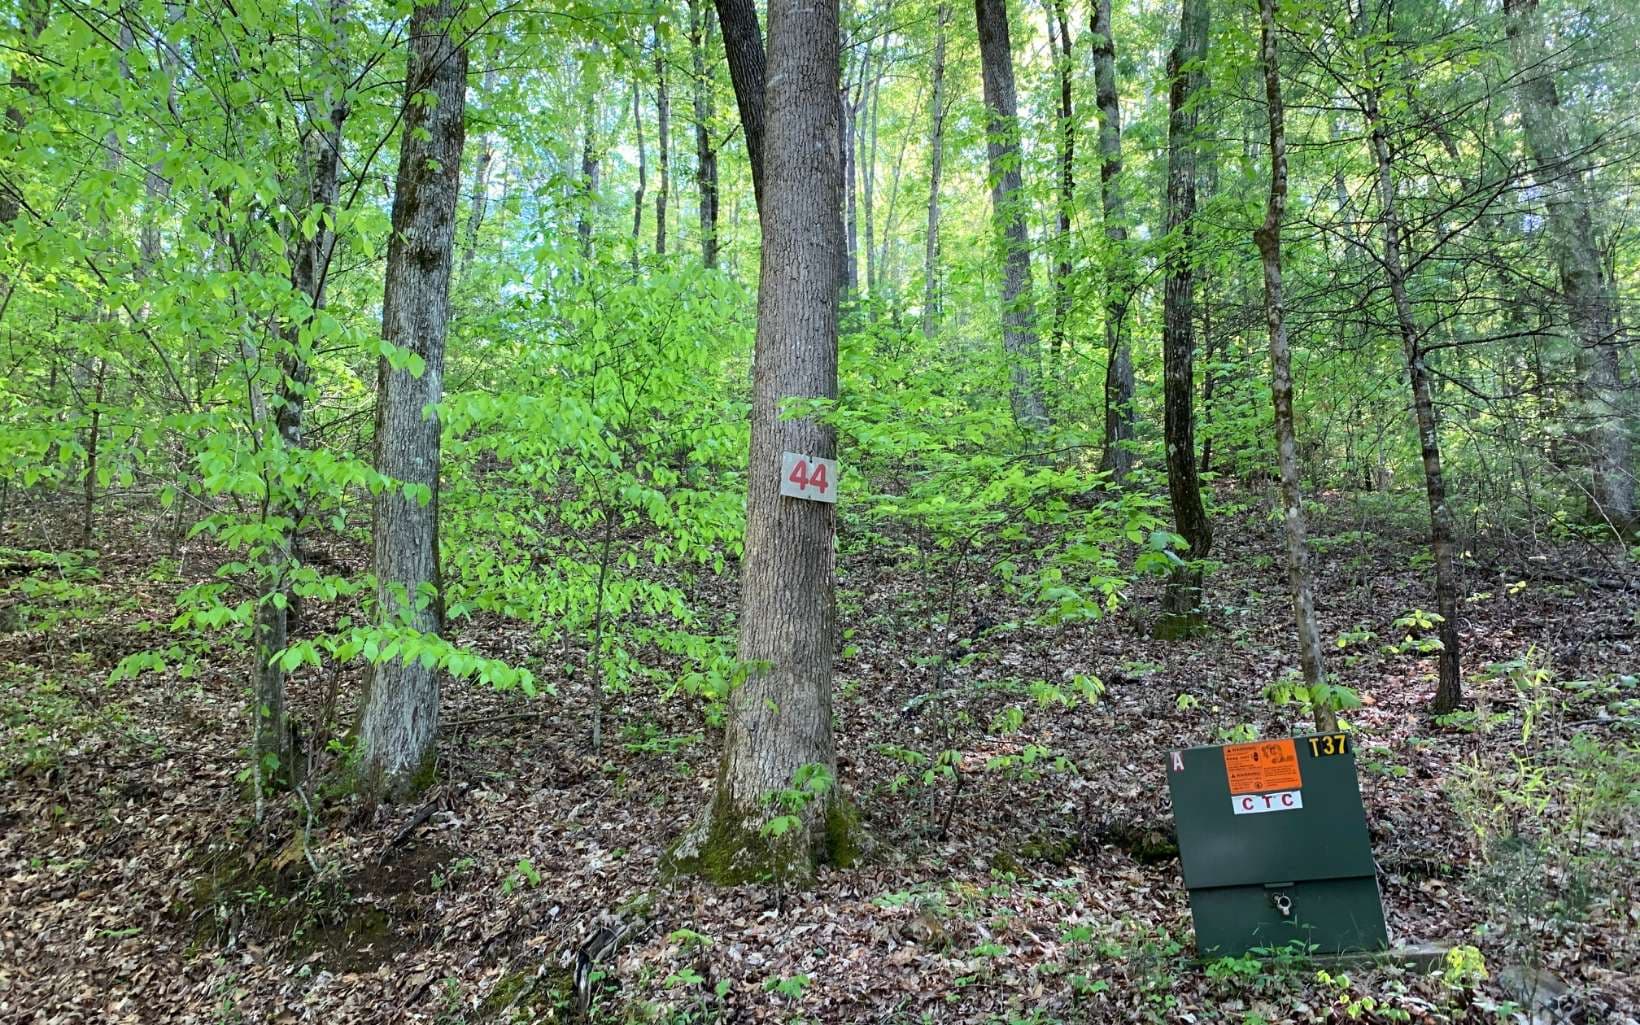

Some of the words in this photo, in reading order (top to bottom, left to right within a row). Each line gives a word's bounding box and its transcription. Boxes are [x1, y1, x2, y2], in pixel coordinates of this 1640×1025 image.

[789, 460, 829, 494] 44
[1308, 734, 1346, 757] T37
[1173, 751, 1185, 771] A
